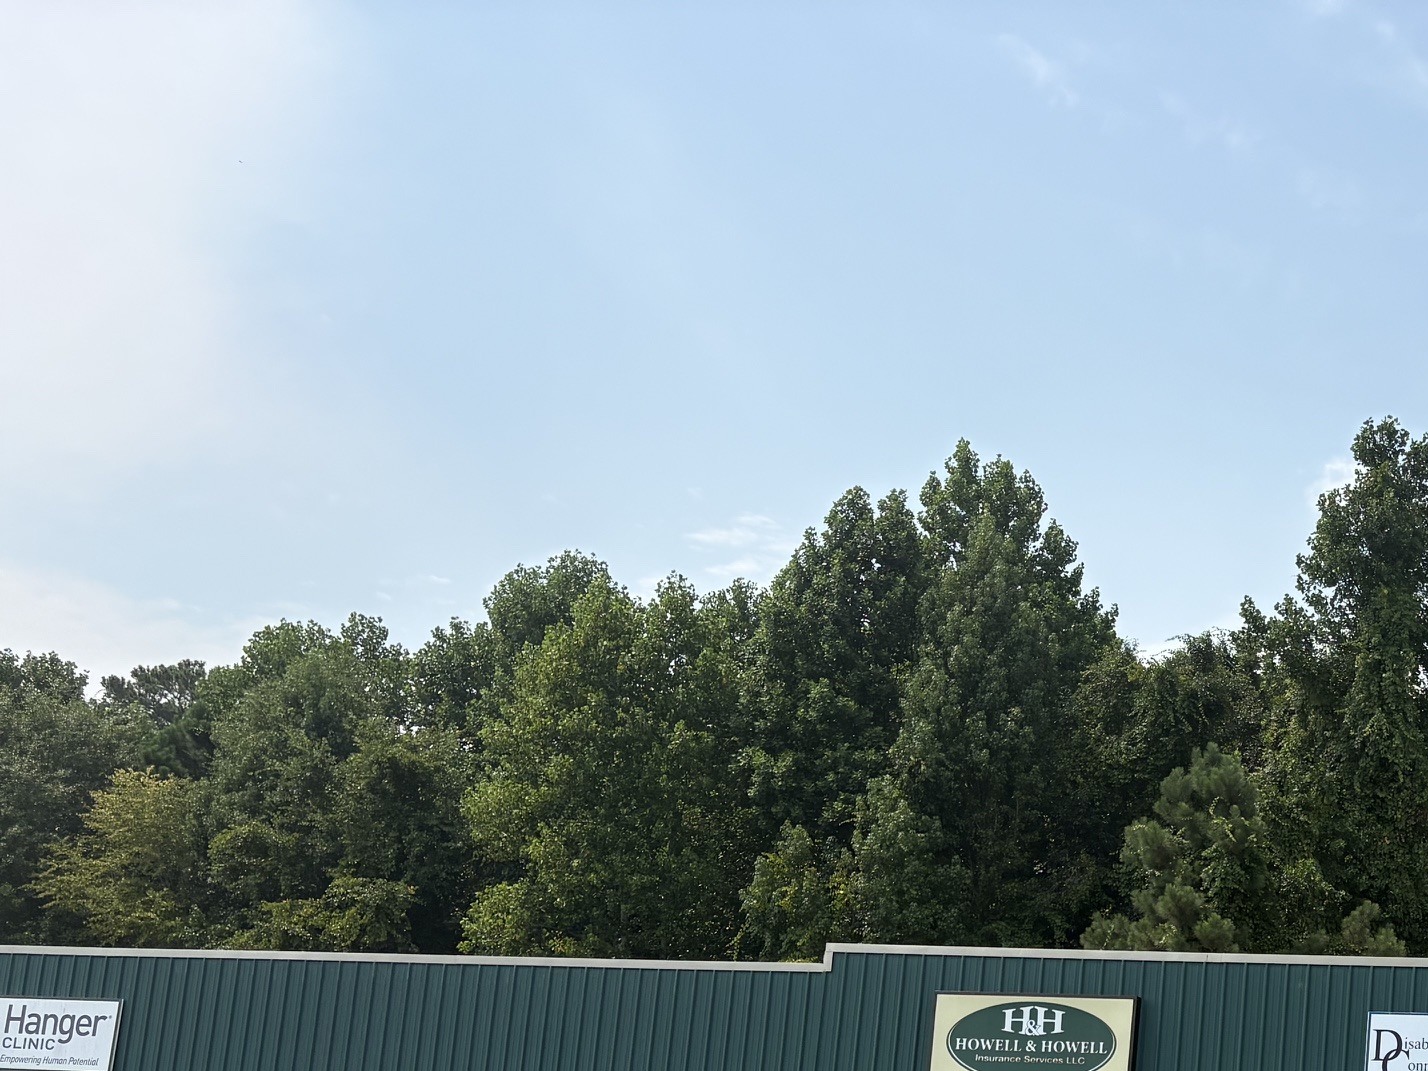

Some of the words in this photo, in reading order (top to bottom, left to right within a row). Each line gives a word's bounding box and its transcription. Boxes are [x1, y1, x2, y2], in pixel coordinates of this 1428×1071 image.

[4, 1004, 108, 1044] Hanger
[2, 1037, 55, 1050] CLINIC
[956, 1038, 1022, 1052] HOWELL
[1026, 1040, 1036, 1052] &
[1042, 1040, 1107, 1055] HOWELL
[0, 1054, 41, 1065] Empowering
[42, 1056, 67, 1065] Human
[68, 1056, 99, 1066] Potential
[975, 1054, 1021, 1063] Insurance
[1024, 1056, 1063, 1064] Services
